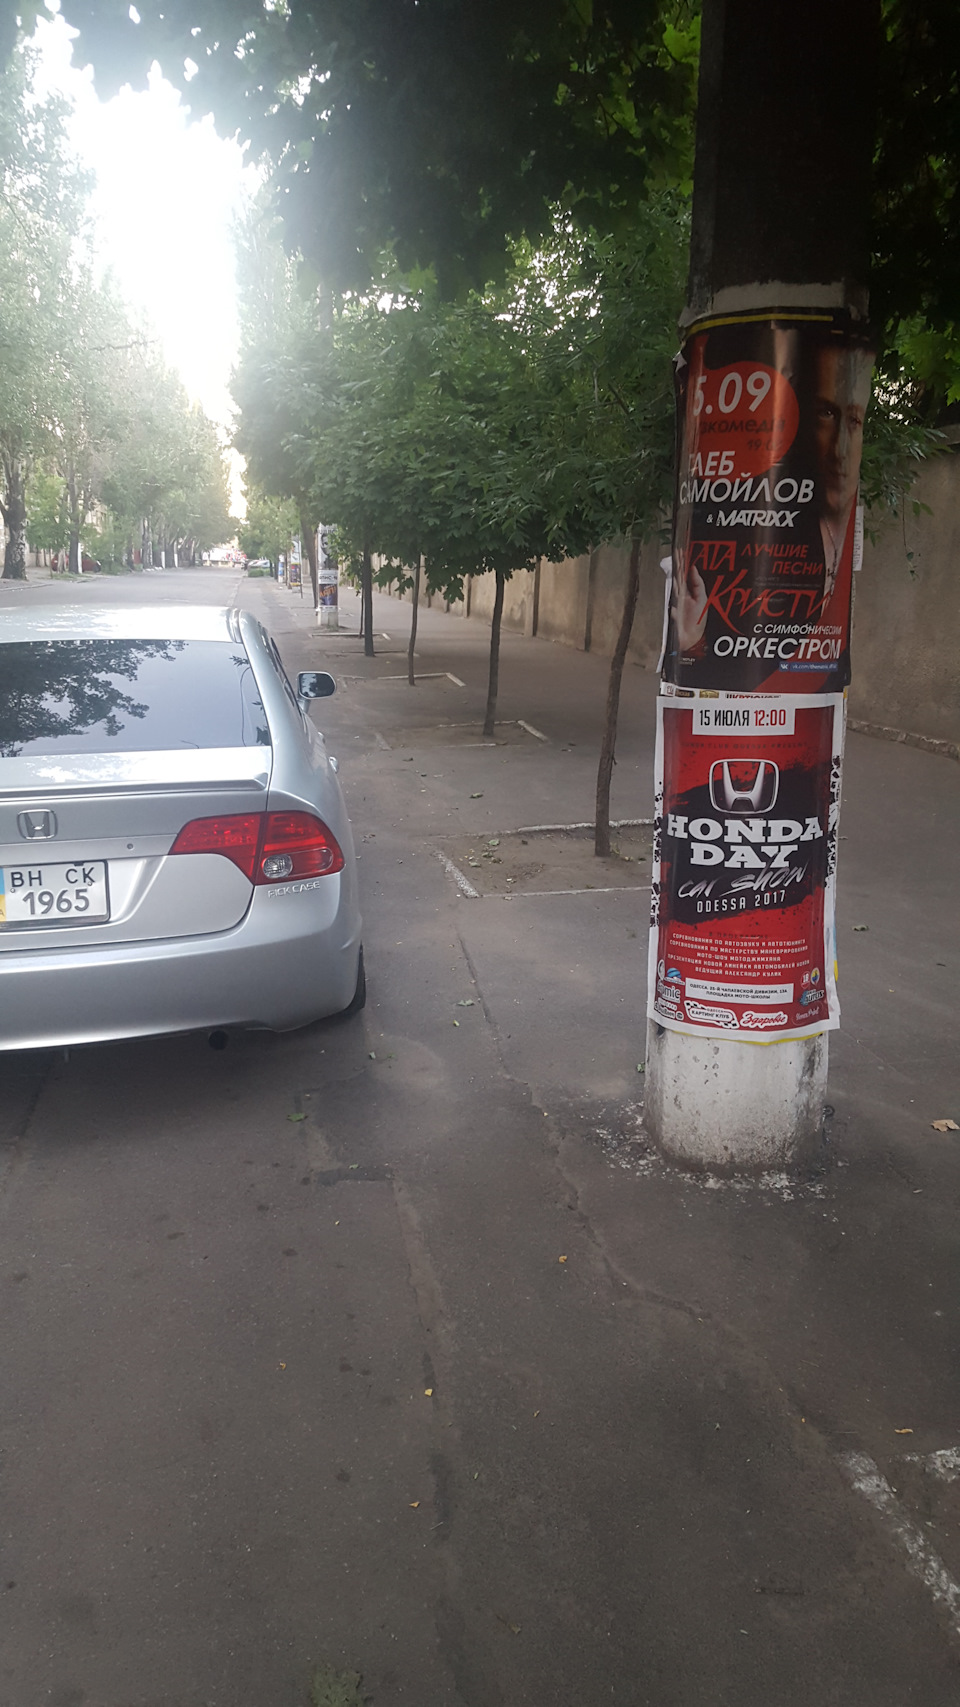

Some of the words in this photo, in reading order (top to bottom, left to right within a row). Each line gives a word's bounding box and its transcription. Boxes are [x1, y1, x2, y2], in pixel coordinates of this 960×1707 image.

[680, 472, 814, 504] САМОЙЛОВ
[706, 514, 713, 523] &
[716, 510, 800, 527] MATRIXX
[740, 544, 808, 559] ЛУЧШИЕ
[771, 561, 823, 575] ПЕСНИ
[753, 623, 763, 634] С
[713, 635, 842, 660] ОРКЕСТРОМ
[700, 709, 711, 726] 15
[714, 709, 750, 727] ИЮЛЯ
[754, 709, 786, 727] 12:00
[667, 813, 823, 843] HONDA
[690, 842, 798, 869] DAY
[22, 888, 90, 915] 1965
[697, 897, 746, 913] ODESSA
[754, 890, 786, 907] 2017
[692, 1010, 715, 1018] КАРТИНГ
